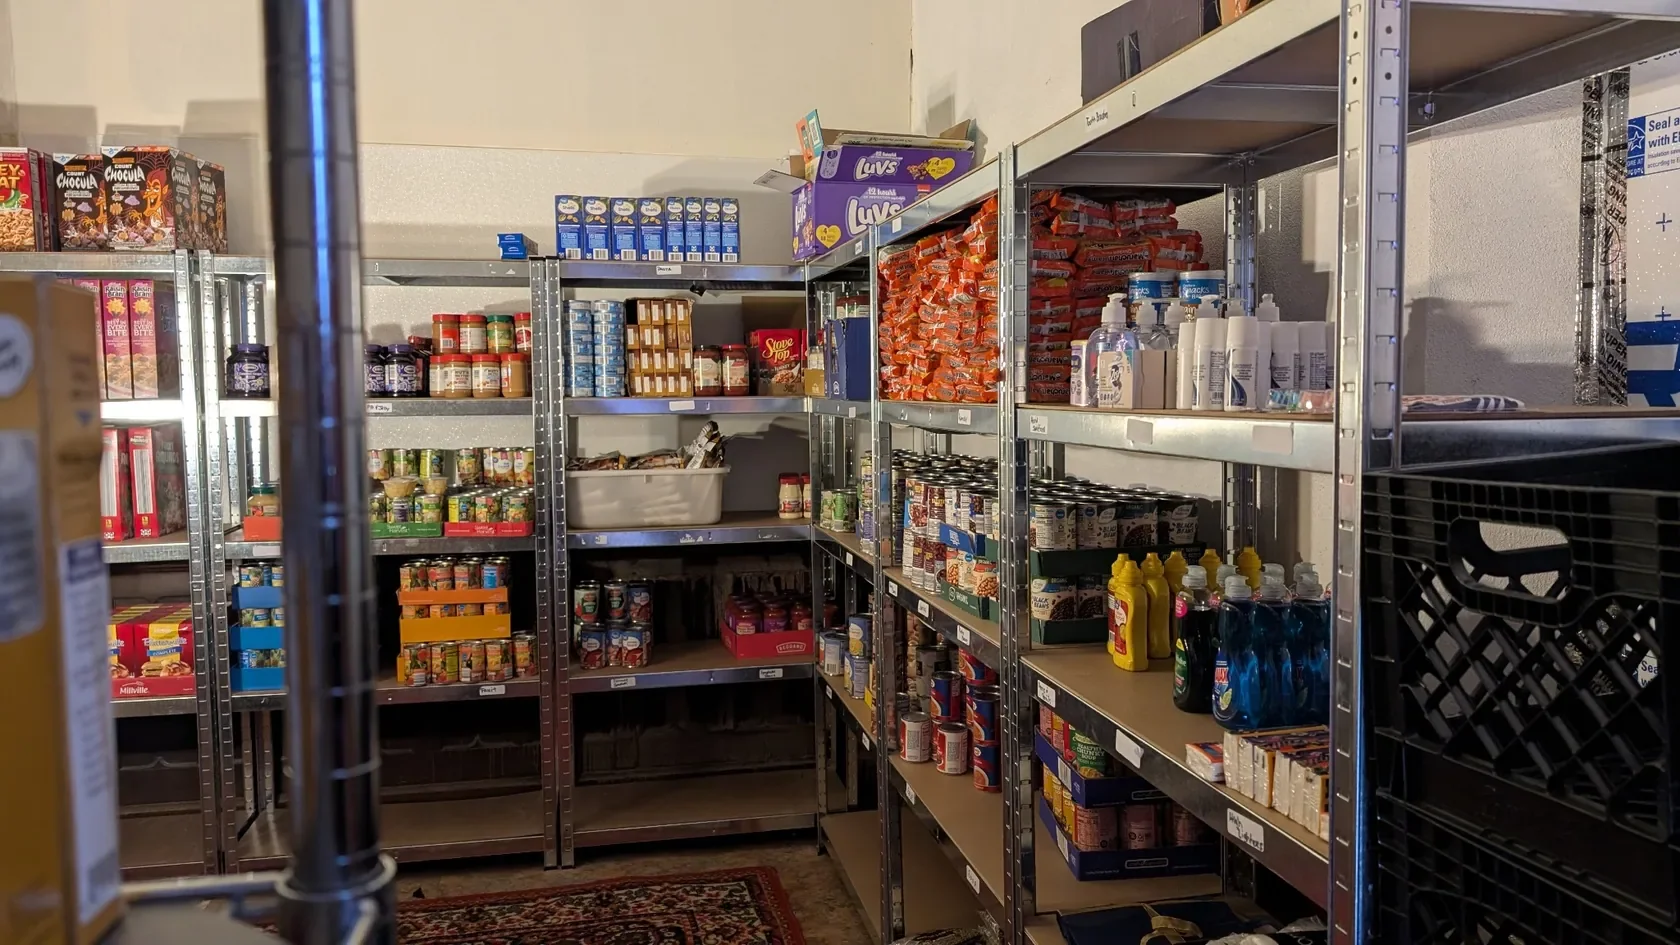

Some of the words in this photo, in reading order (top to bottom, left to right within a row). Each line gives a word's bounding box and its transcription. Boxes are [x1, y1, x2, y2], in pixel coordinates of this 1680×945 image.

[1649, 116, 1671, 131] Seal
[1674, 117, 1680, 126] a
[1648, 134, 1670, 148] with
[0, 164, 20, 176] EY
[104, 165, 146, 182] CHOCULA
[855, 158, 898, 180] Luvs
[56, 173, 99, 190] CHOCULA
[762, 338, 795, 359] Stove
[773, 350, 790, 363] Top
[1641, 660, 1658, 675] Sea
[119, 686, 149, 695] Millville
